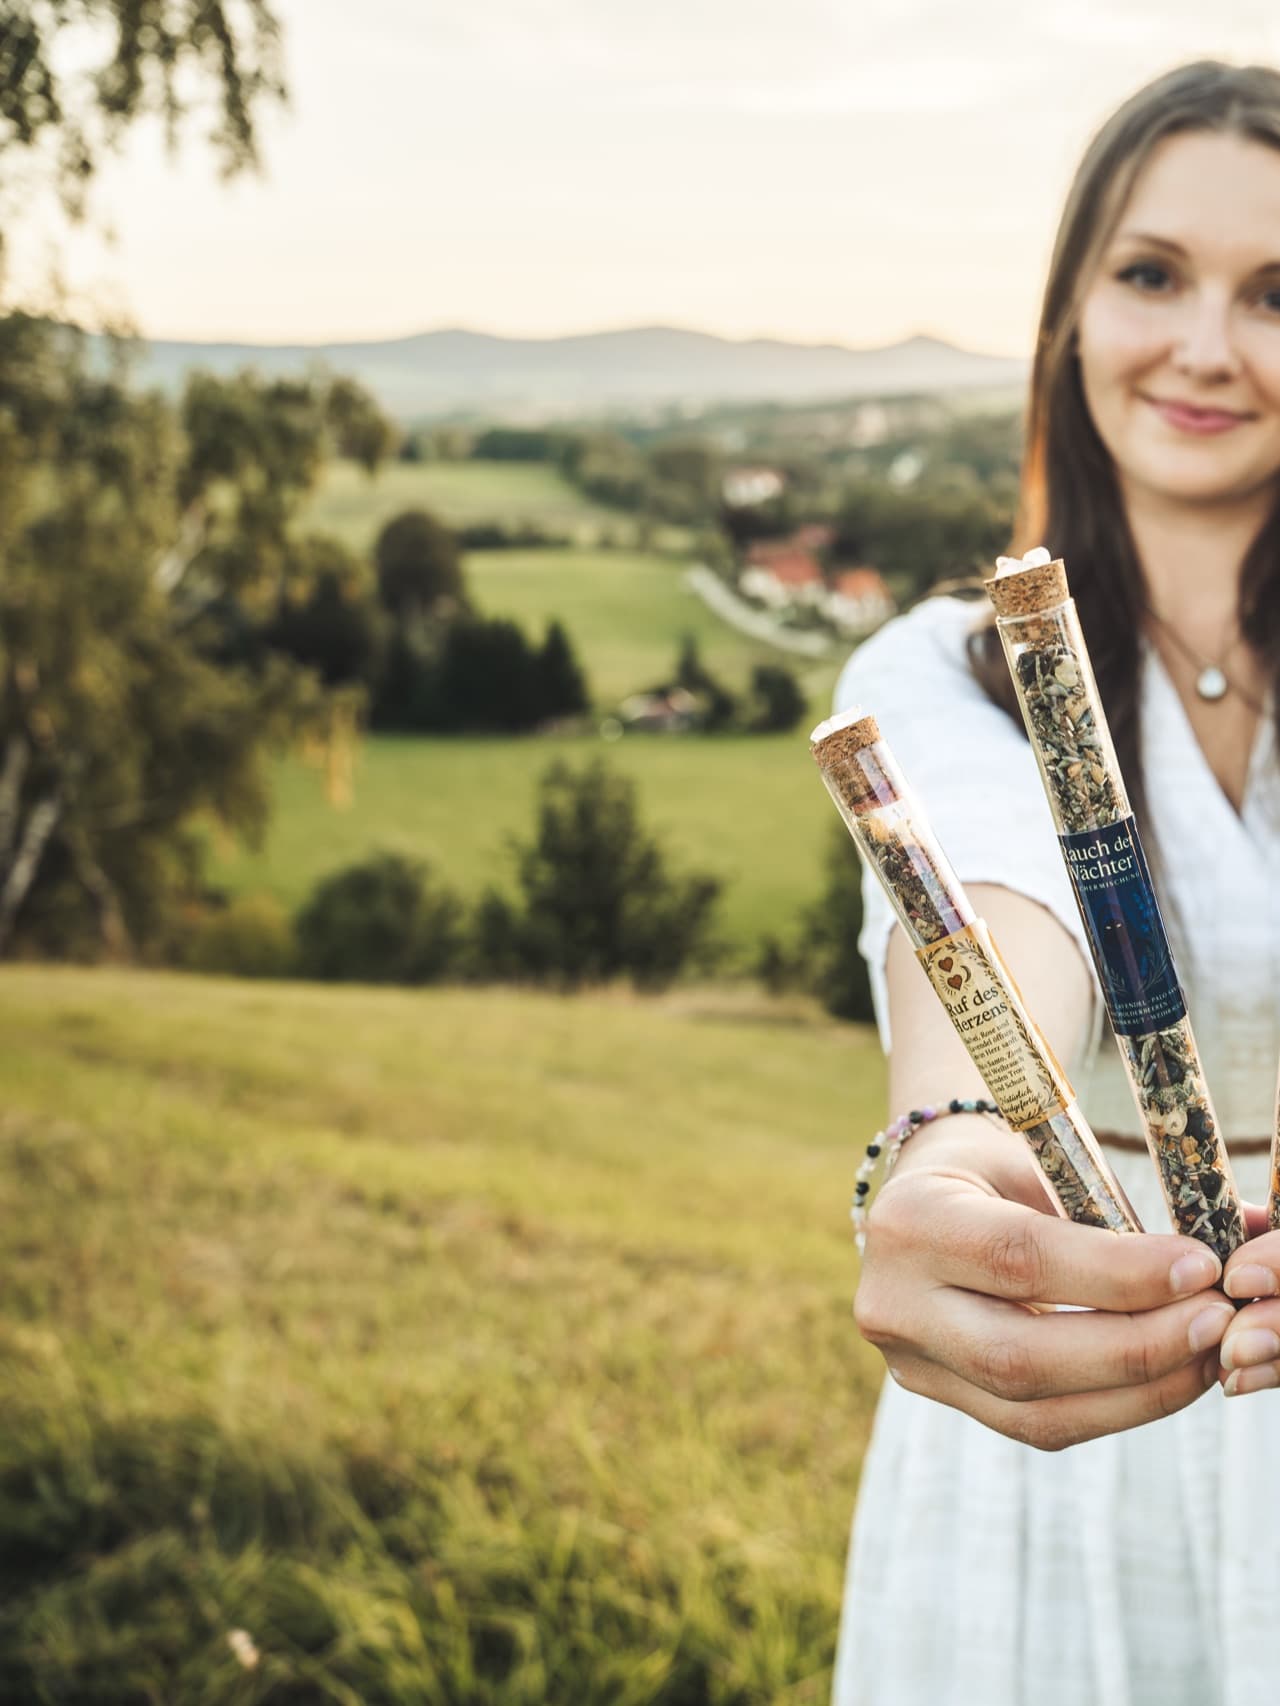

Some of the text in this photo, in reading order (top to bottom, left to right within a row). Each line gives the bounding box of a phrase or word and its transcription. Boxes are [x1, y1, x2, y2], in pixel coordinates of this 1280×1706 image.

[1066, 840, 1110, 862] auch
[945, 986, 999, 1017] Ruf des
[951, 1001, 1008, 1033] Herzens
[985, 1046, 1000, 1057] Herz
